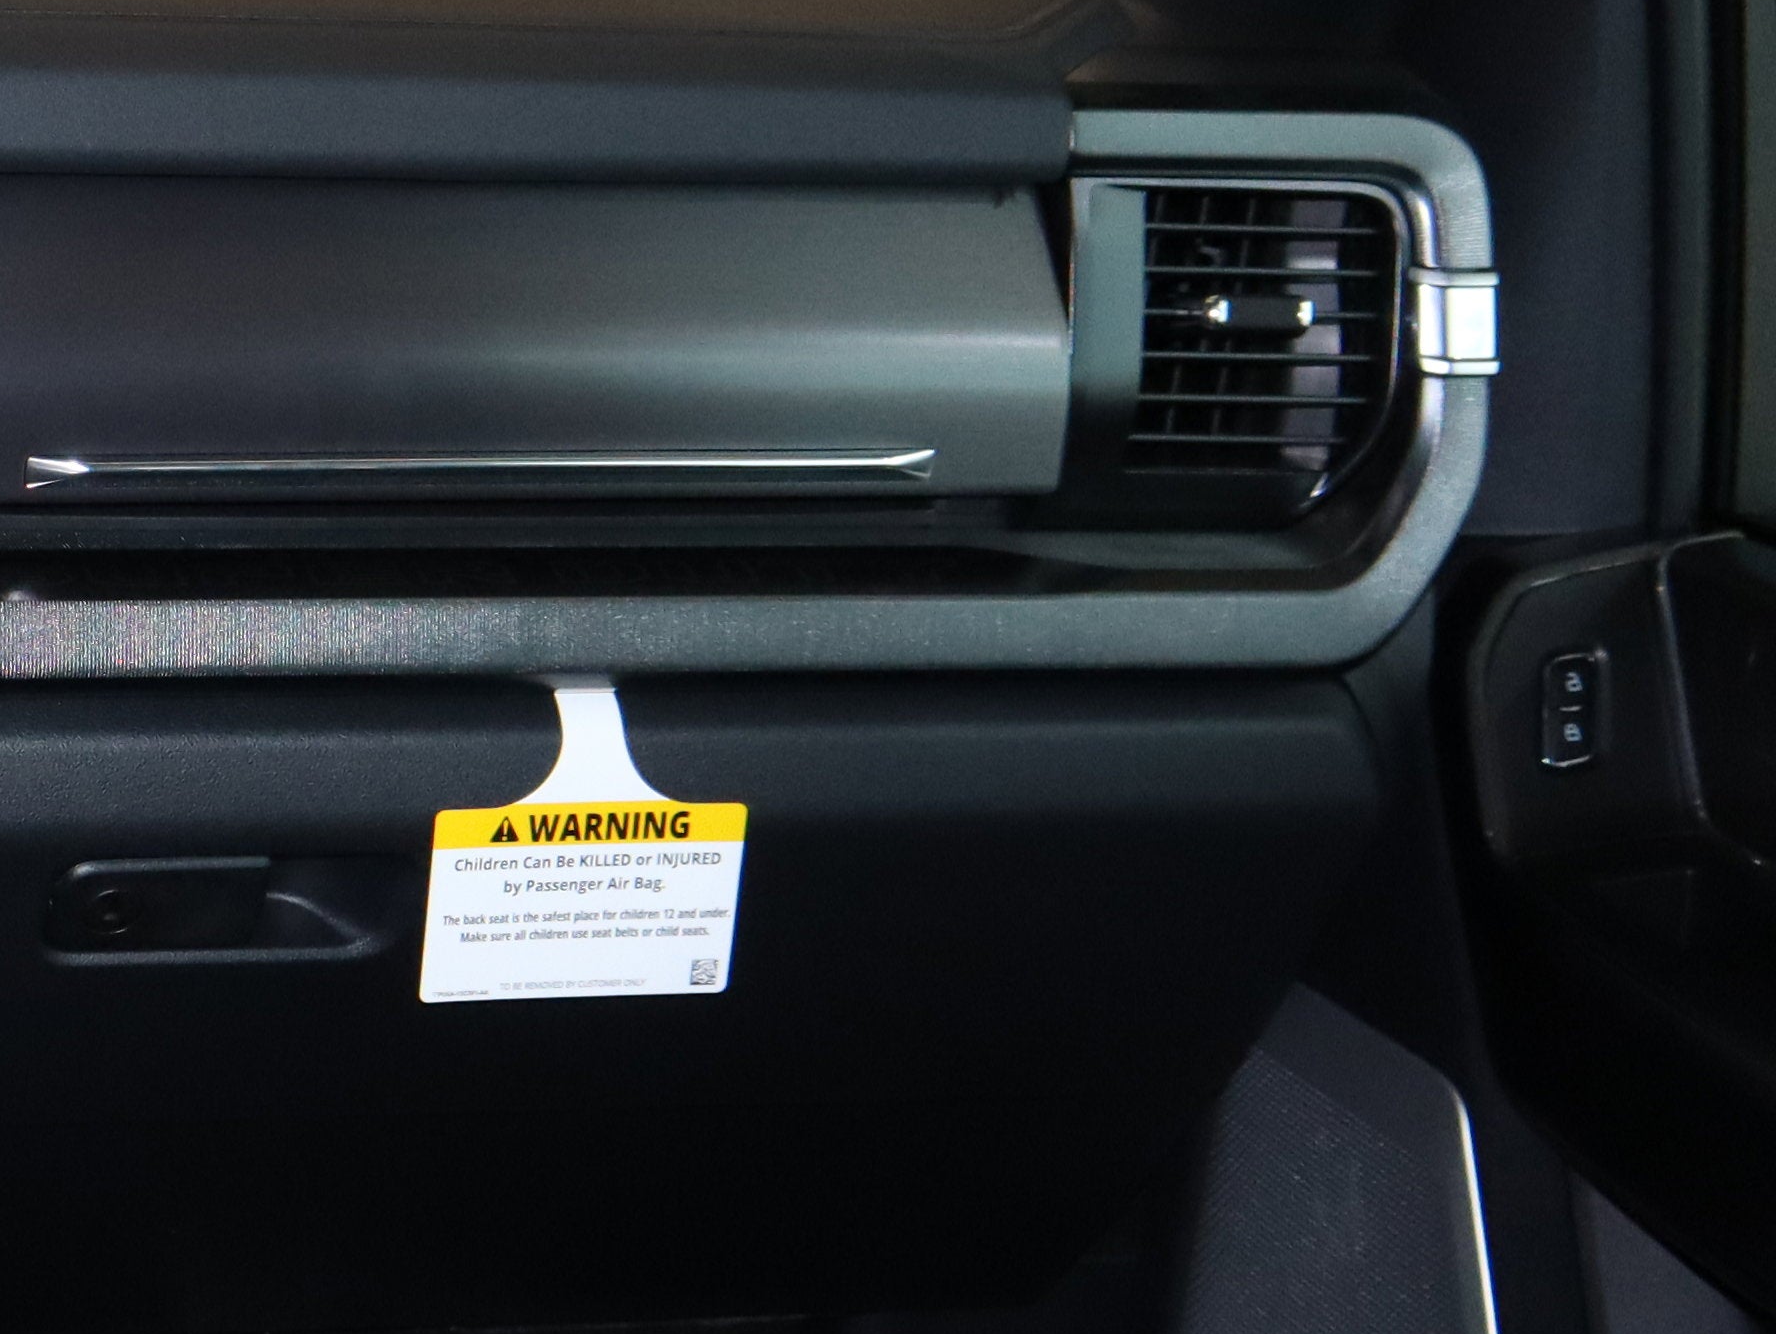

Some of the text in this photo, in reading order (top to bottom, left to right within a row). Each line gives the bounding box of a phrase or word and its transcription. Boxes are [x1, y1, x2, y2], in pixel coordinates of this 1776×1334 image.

[528, 810, 691, 843] WARNING
[454, 851, 723, 872] Children Can Be KILLED or INJURED
[503, 875, 667, 897] by Passenger Air Bag.
[443, 908, 730, 926] The back seat is the safest place for children 12 and under.
[459, 925, 710, 943] Make sure all children use seat belts or child seats.
